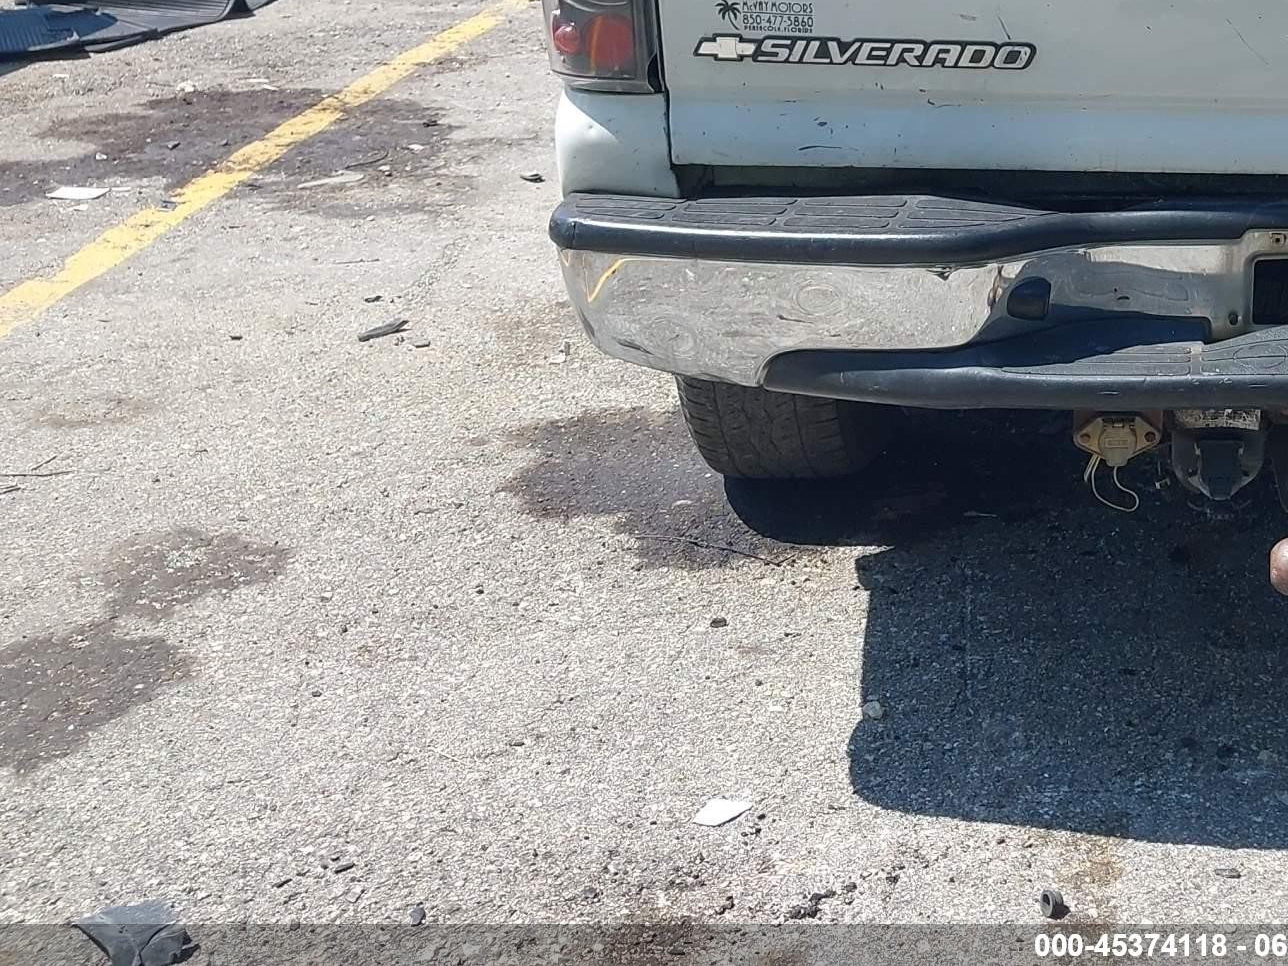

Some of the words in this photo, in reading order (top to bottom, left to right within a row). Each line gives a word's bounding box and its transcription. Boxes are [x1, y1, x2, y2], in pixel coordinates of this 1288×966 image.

[770, 2, 814, 14] MOTORS
[742, 14, 814, 28] 850-477-5860
[753, 37, 1035, 70] SILVERADO
